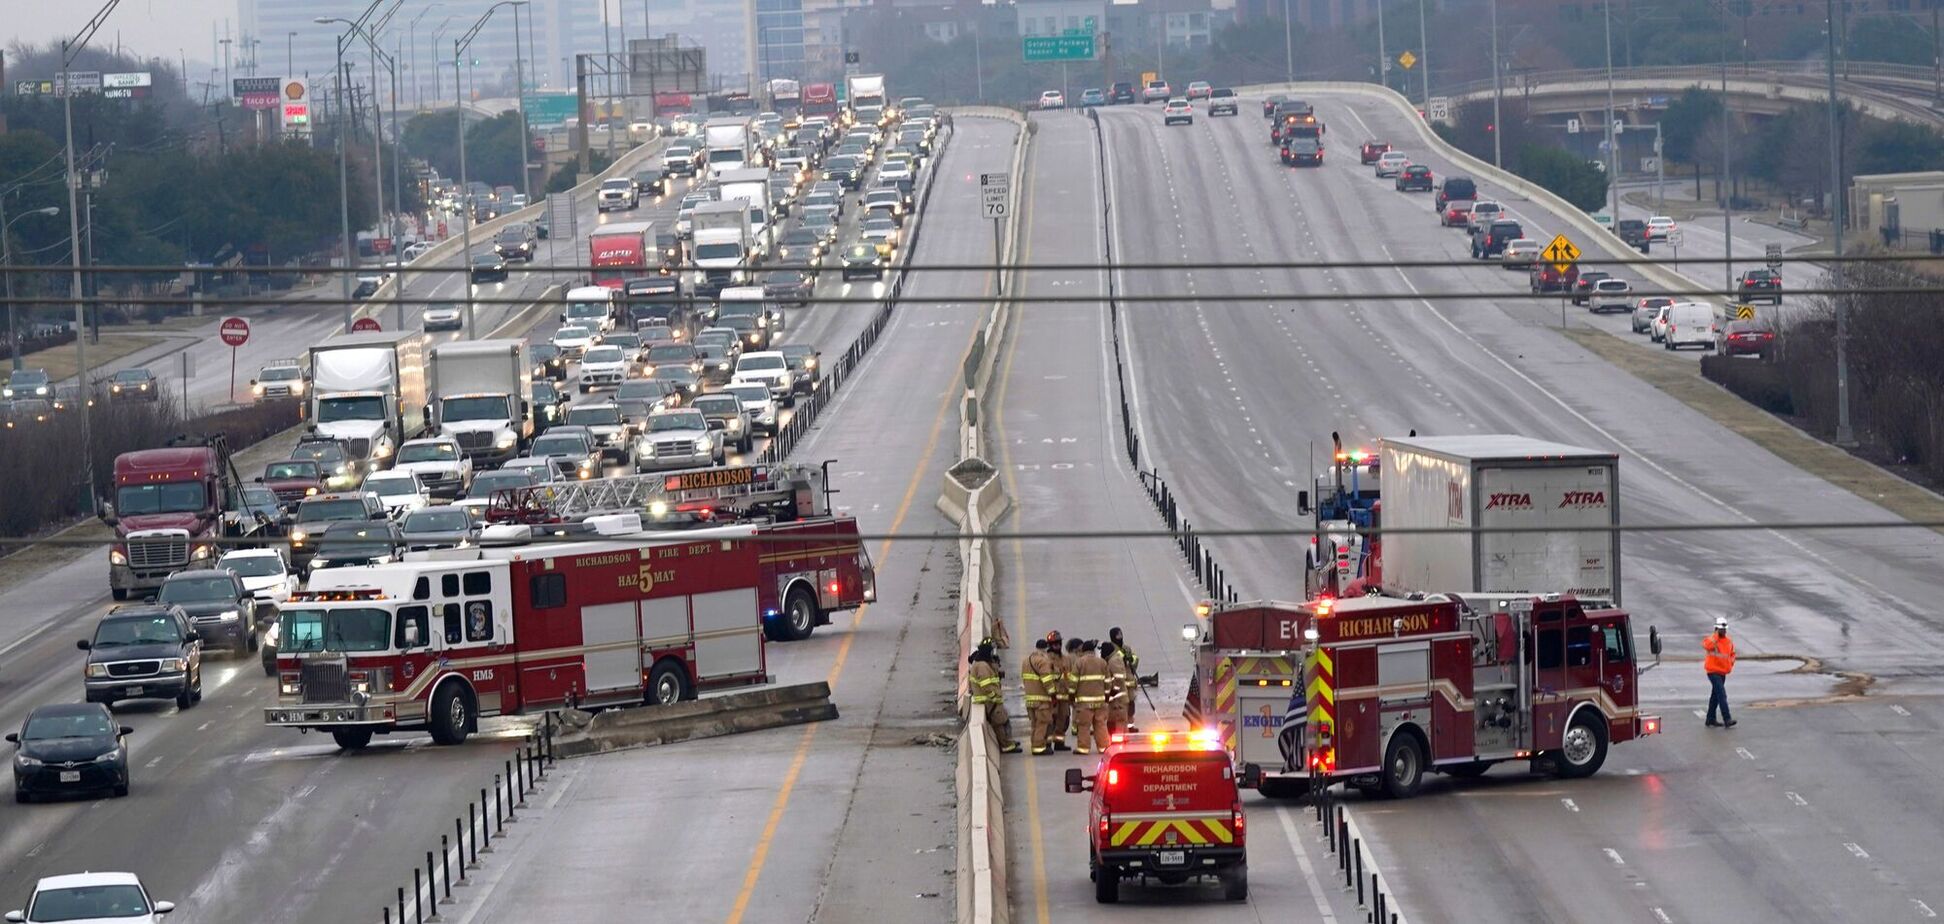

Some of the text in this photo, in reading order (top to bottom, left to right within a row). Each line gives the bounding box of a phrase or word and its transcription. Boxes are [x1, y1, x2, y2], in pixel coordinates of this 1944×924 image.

[1432, 110, 1446, 118] 70
[986, 203, 1005, 215] 70
[681, 467, 752, 489] RICHARDSON
[1485, 492, 1531, 511] XTRA
[1558, 490, 1605, 509] XTRA
[575, 553, 631, 567] RICHARDSON
[658, 548, 679, 559] FIRE
[617, 563, 676, 593] HAZ 5 MAT
[1280, 620, 1299, 639] E1
[1339, 613, 1429, 637] RICHARSON
[472, 670, 494, 681] HM5
[289, 711, 330, 722] HM 5
[1243, 715, 1287, 728] ENGIN
[1259, 704, 1275, 738] 1
[1143, 764, 1198, 774] RICHARDSON
[1161, 774, 1180, 782] FIRE
[1143, 783, 1198, 793] DEPARTMENT
[1166, 793, 1177, 811] 1
